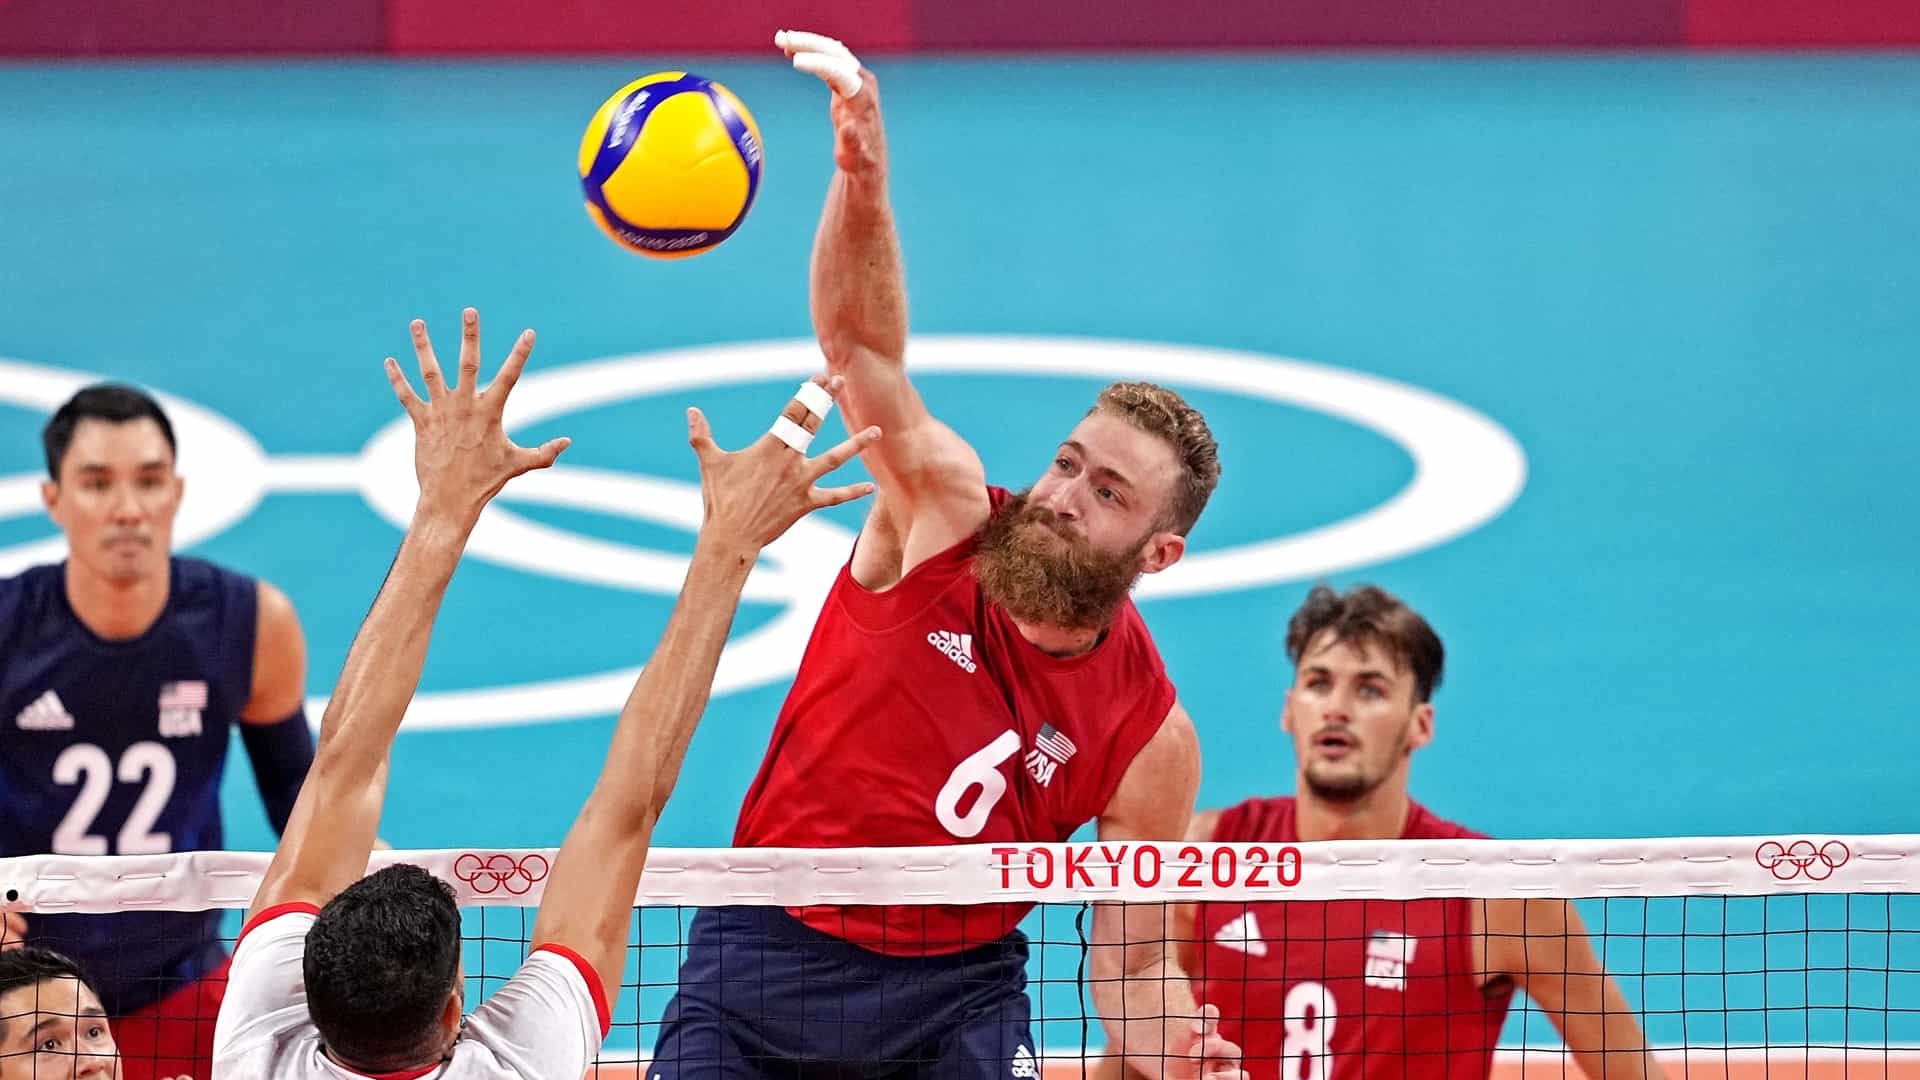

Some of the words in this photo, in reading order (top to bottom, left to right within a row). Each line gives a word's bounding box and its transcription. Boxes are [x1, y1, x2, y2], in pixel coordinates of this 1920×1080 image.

[927, 632, 977, 673] adidas
[52, 741, 177, 855] 22
[935, 729, 1022, 838] 6
[1024, 749, 1058, 788] USA
[992, 845, 1160, 889] TOKYO
[1177, 846, 1302, 888] 2020
[1279, 981, 1338, 1080] 8
